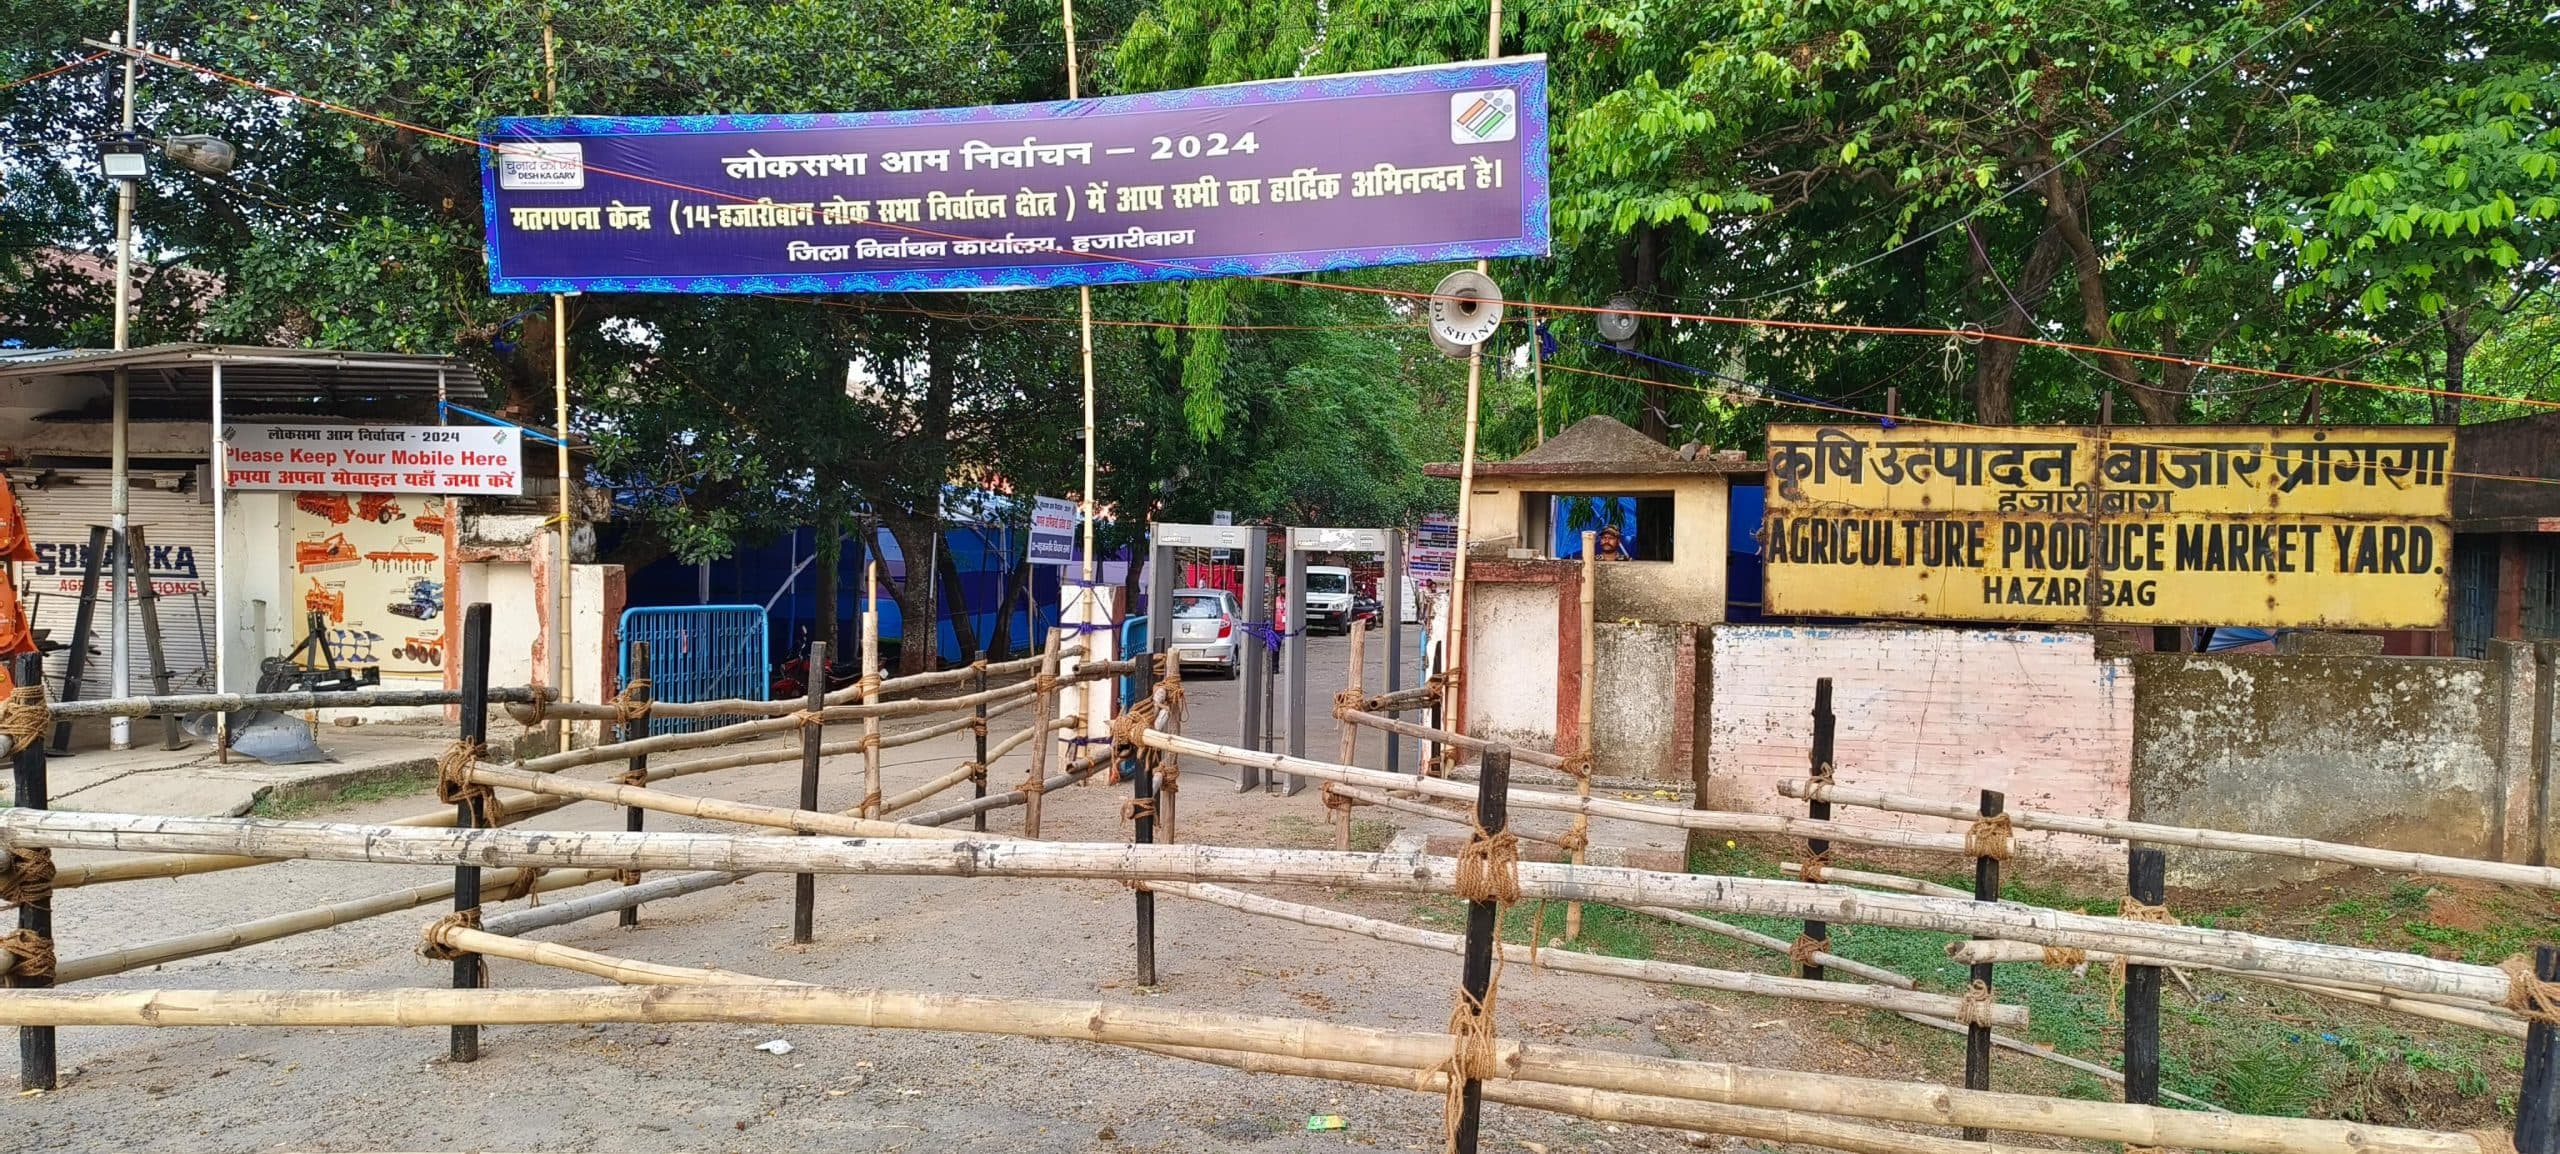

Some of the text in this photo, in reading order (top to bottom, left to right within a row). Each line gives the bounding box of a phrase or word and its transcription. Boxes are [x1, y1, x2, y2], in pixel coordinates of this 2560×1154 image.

[721, 149, 867, 179] लोकसभा
[880, 149, 950, 173] आम
[959, 137, 1093, 171] निर्वाचन
[1150, 131, 1260, 160] 2024
[518, 172, 576, 180] DESH KA GARV
[510, 206, 601, 231] मतगणना
[606, 200, 651, 231] केन्द्र
[821, 195, 871, 225] लोक
[877, 198, 921, 223] सभा
[927, 189, 1008, 221] निर्वाचन
[1085, 181, 1109, 213] में
[1117, 185, 1164, 212] आप
[1171, 175, 1220, 209] सभी
[1227, 178, 1261, 205] का
[1268, 167, 1342, 203] हार्दिक
[1352, 163, 1466, 197] अभिनन्दन
[787, 240, 850, 262] जिला
[855, 237, 947, 260] निर्वाचन
[1072, 226, 1195, 253] हजारीबाग
[267, 427, 321, 440] लोकसभा
[327, 430, 353, 441] आम
[358, 428, 405, 442] निर्वाचन
[422, 431, 460, 442] 2024
[226, 448, 507, 467] Please Keep Your Mobile Here
[1770, 428, 1869, 500] कृषि
[1869, 441, 2077, 487] उत्पादन
[2103, 442, 2264, 488] बाजार
[228, 470, 271, 488] कृपया
[278, 471, 325, 485] अपना
[331, 468, 397, 487] मोबाइल
[442, 473, 480, 488] जमा
[486, 471, 515, 488] करें
[1998, 481, 2174, 513] हजारीबाग
[1768, 516, 2445, 575] AGRICULTURE PRODUCE MARKET YARD.
[59, 579, 199, 595] AGR SLIONS
[1983, 576, 2157, 607] HAZARIBAG
